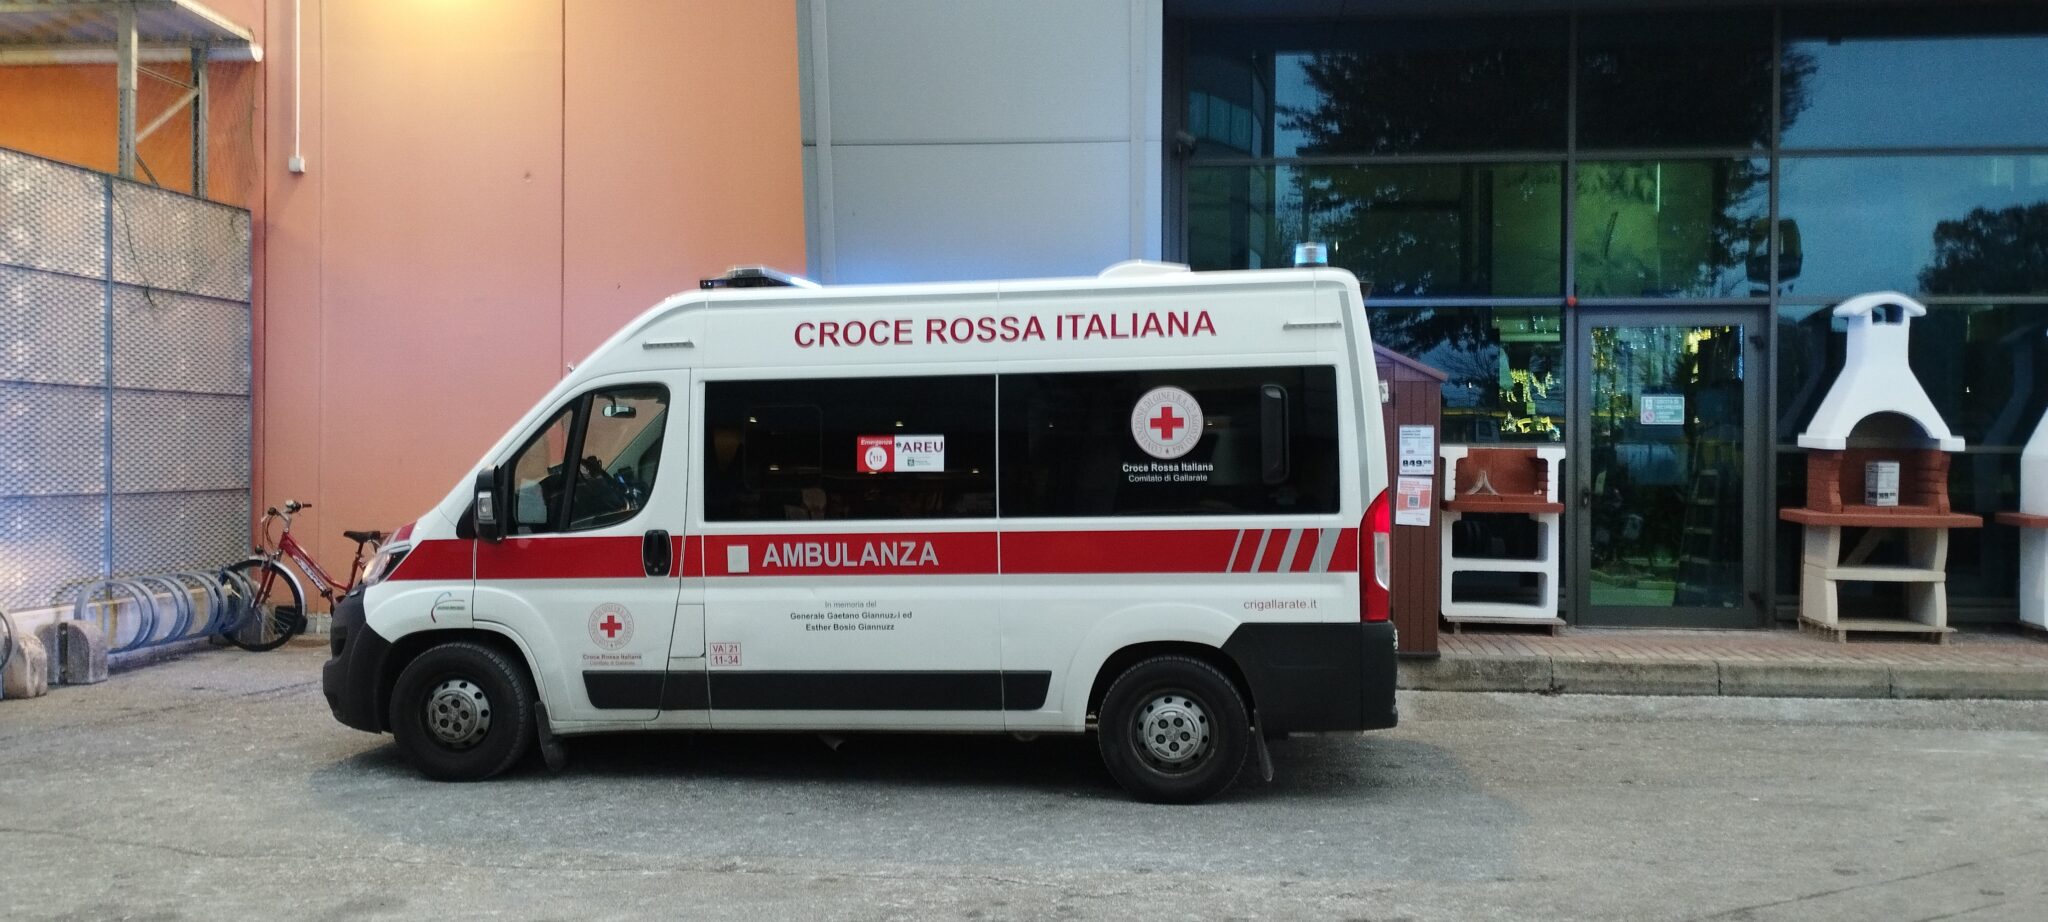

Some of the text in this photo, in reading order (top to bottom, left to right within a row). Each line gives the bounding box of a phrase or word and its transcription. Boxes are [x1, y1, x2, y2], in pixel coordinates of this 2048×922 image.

[794, 309, 1217, 349] CROCE ROSSA ITALIANA
[902, 441, 944, 453] AREU
[1122, 461, 1214, 473] Croce Rossa Italiana
[1128, 473, 1208, 483] Comitato di Gallarate
[762, 541, 939, 568] AMBULANZA
[866, 600, 877, 608] del
[1243, 599, 1317, 611] crigallarate.it
[790, 612, 825, 620] Generale
[827, 612, 860, 620] Gaetano
[902, 611, 913, 619] ed
[805, 623, 831, 631] Esther
[833, 623, 856, 631] Bosio
[712, 644, 738, 653] VA 21
[713, 655, 738, 664] 11-34
